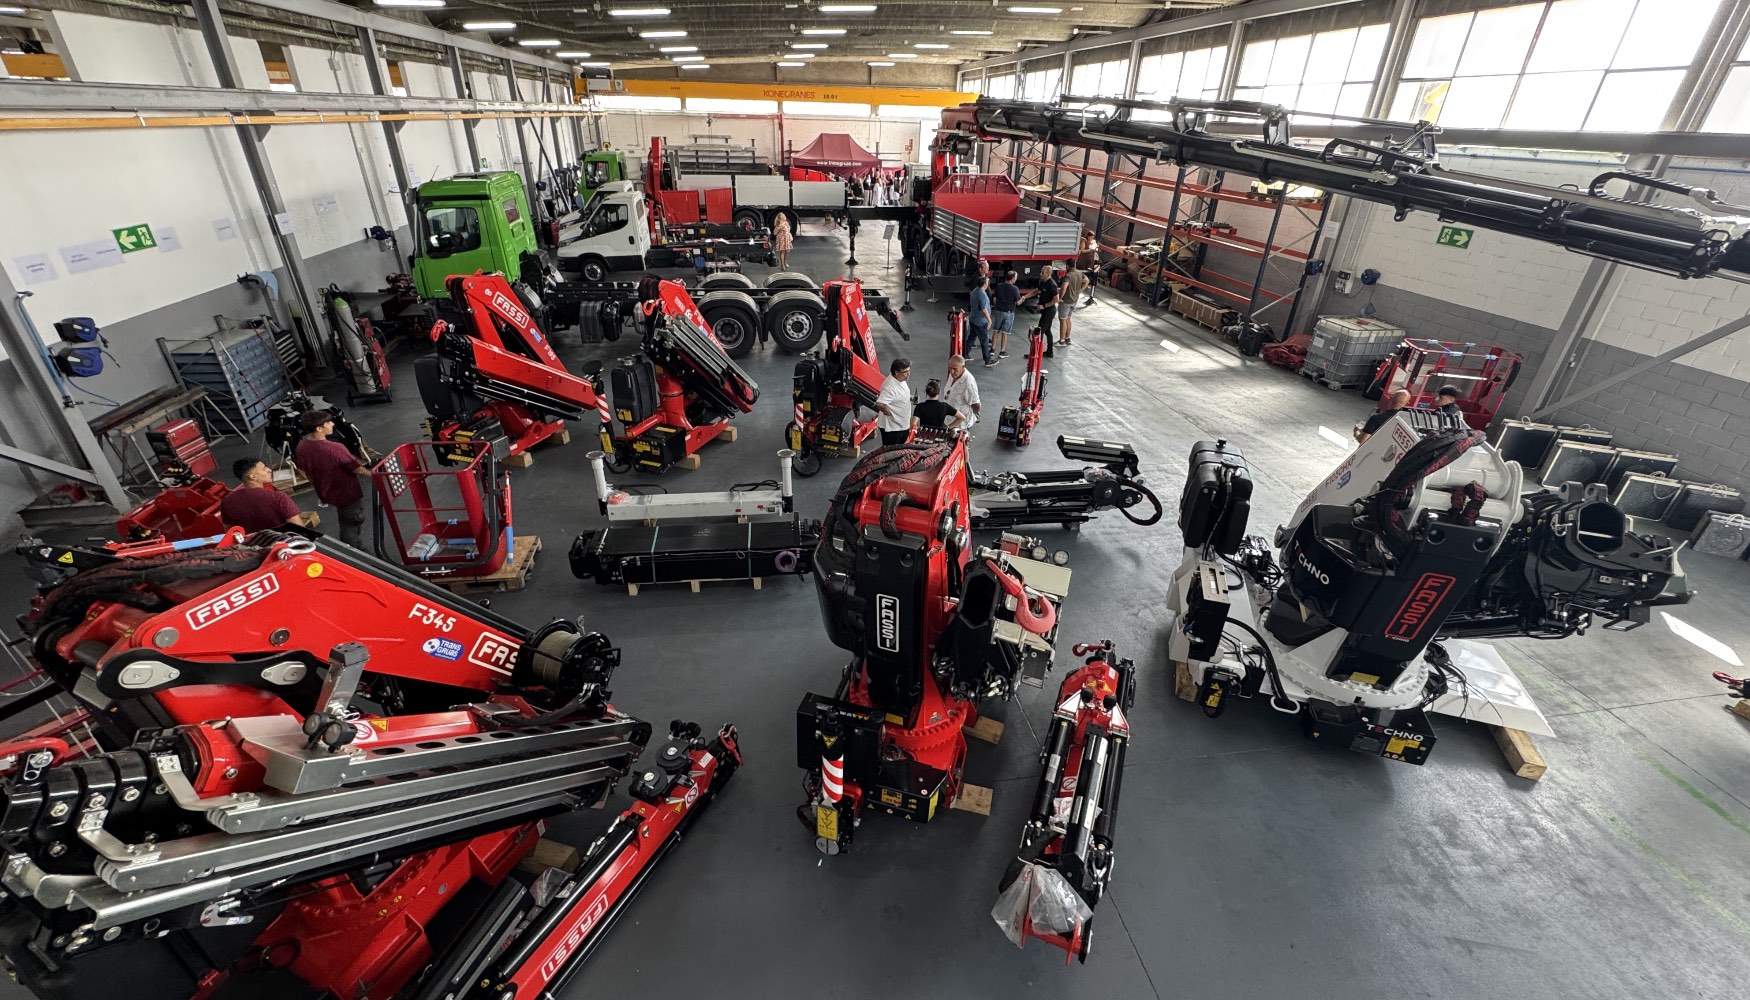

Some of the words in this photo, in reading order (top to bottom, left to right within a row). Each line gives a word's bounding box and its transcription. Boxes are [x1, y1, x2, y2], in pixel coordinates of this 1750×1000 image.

[496, 296, 528, 325] FASSI
[196, 579, 272, 624] FASSI
[408, 602, 458, 633] F345
[881, 598, 894, 648] FASSI
[1399, 577, 1447, 634] FASSI
[1366, 723, 1424, 742] TECHNO
[547, 902, 603, 972] FASSI
